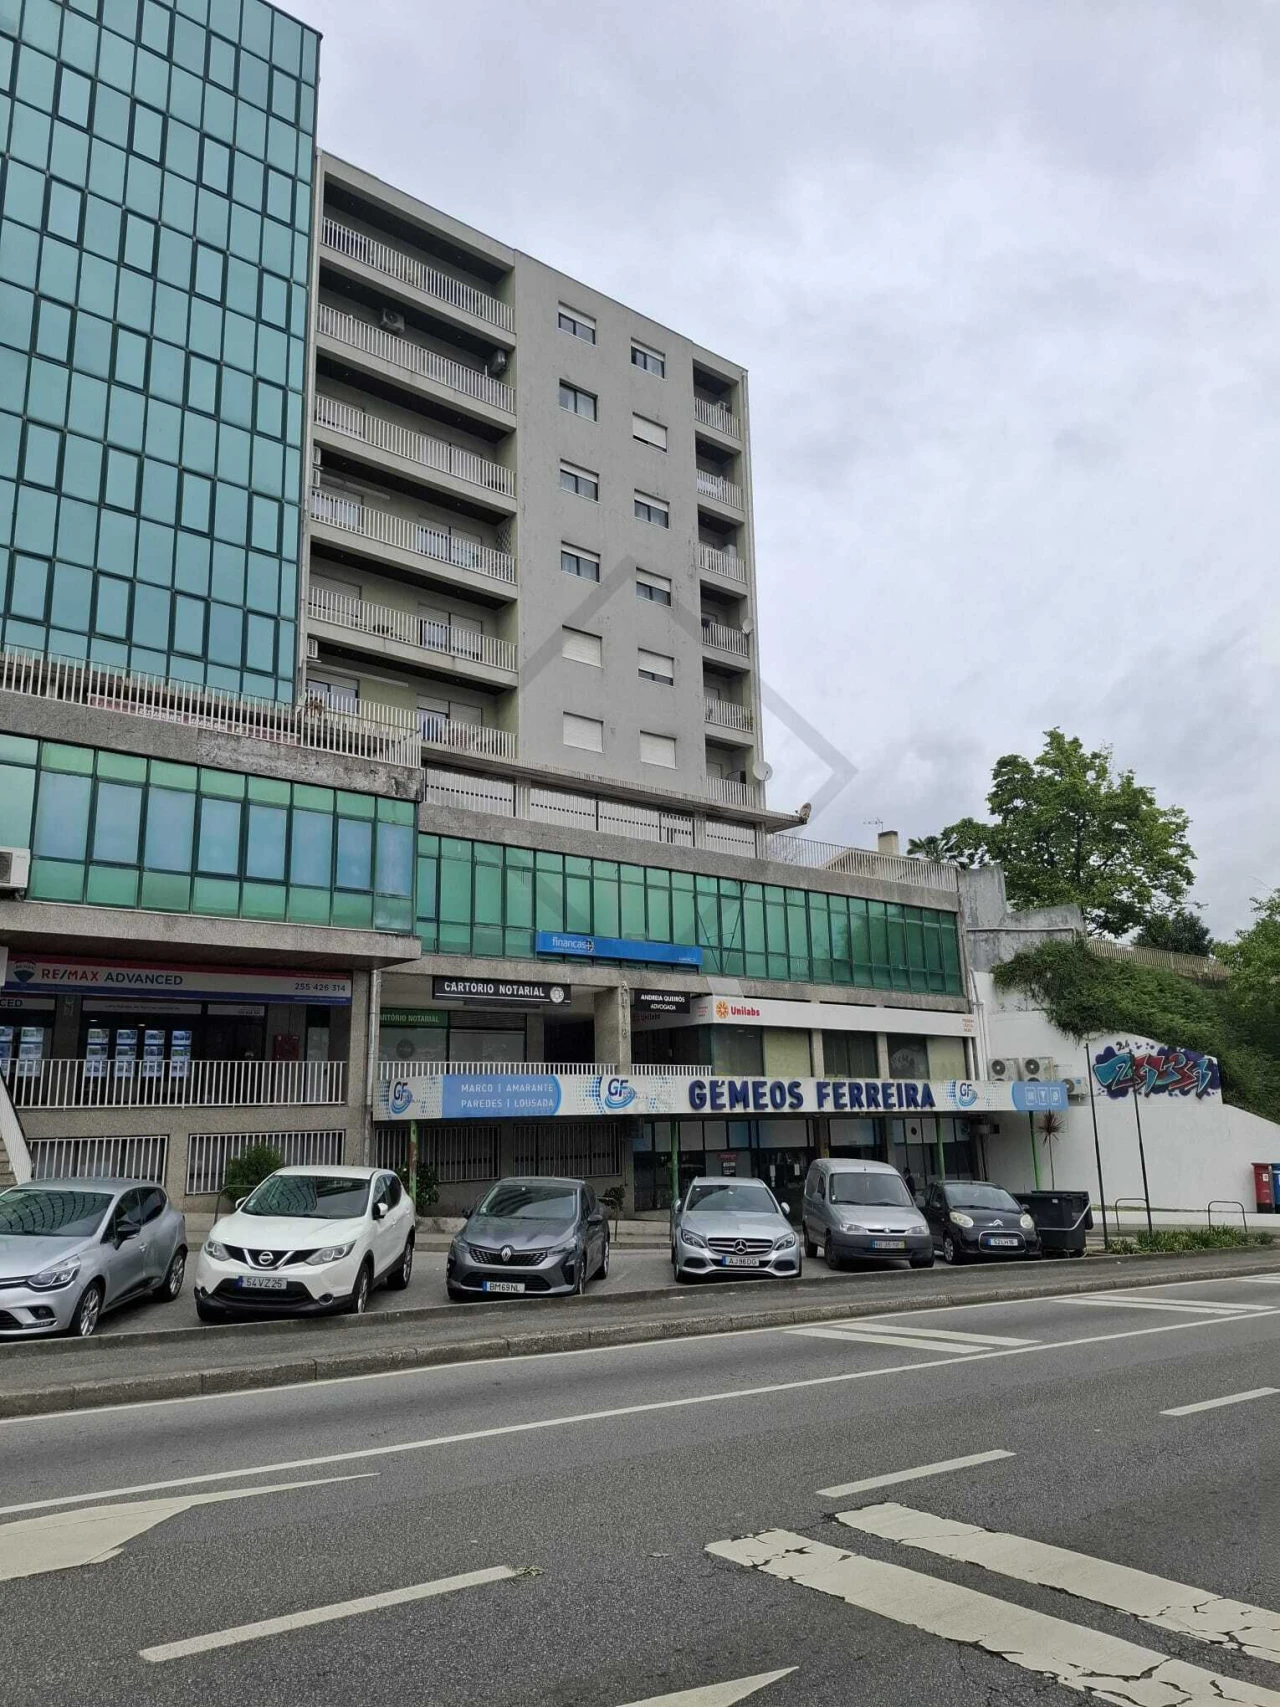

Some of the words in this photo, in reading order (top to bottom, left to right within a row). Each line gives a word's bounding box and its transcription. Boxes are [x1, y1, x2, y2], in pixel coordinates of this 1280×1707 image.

[41, 968, 100, 982] RE/MAX
[103, 971, 184, 986] ADVANCED
[294, 982, 310, 991] 255
[313, 983, 330, 992] 426
[331, 984, 346, 992] 314
[444, 980, 494, 994] CARTÓRIO
[499, 984, 545, 997] NOTARIAL
[731, 1005, 760, 1017] Unilabs
[408, 1014, 440, 1023] NOTARIAL
[394, 1081, 409, 1102] GF
[461, 1083, 493, 1093] MARCO
[506, 1083, 554, 1092] AMARANTE
[608, 1078, 629, 1097] GF
[960, 1083, 973, 1097] GF
[688, 1079, 804, 1111] GÉMEOS
[816, 1080, 937, 1110] FERREIRA
[461, 1099, 502, 1109] PAREDES
[514, 1098, 555, 1108] LOUSADA
[489, 1282, 521, 1292] BM69NL
